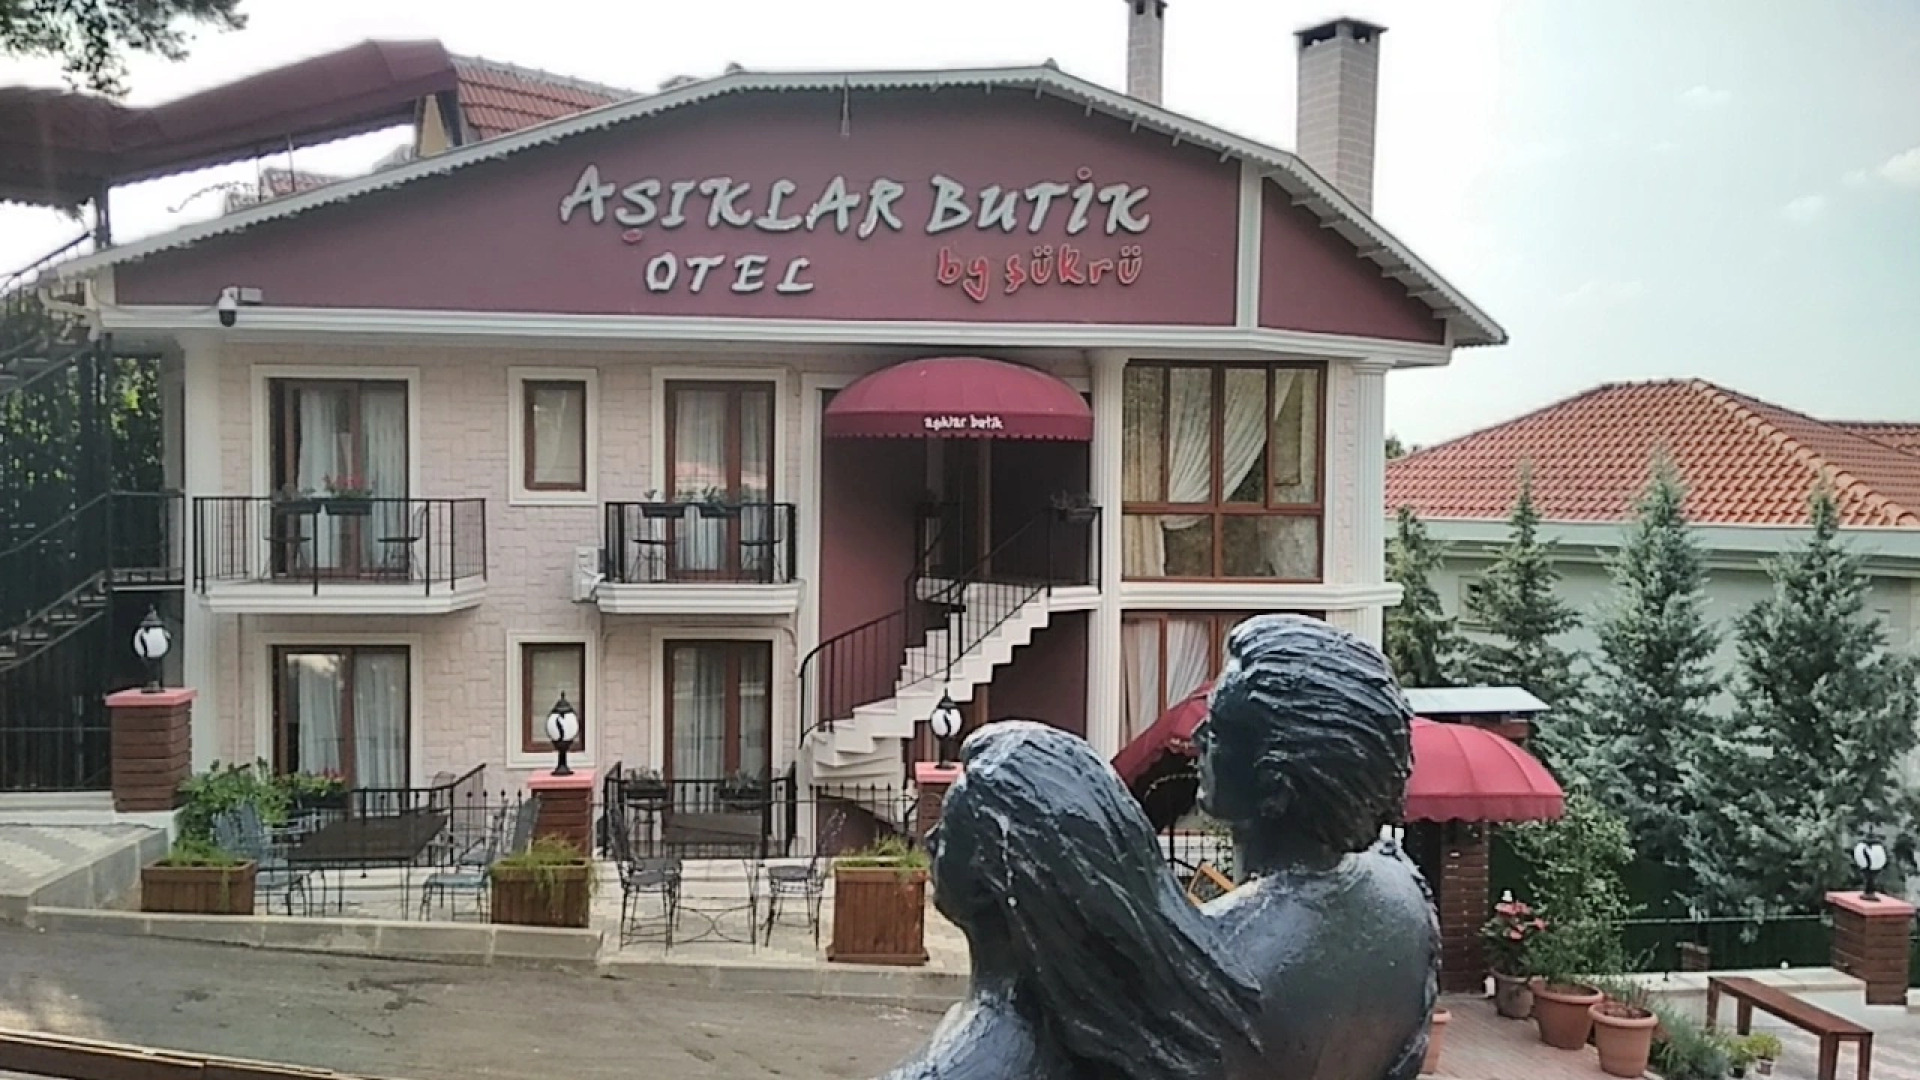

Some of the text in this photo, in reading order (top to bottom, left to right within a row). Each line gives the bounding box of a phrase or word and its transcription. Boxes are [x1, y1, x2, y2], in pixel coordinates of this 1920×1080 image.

[559, 164, 1151, 245] AŞIKLAR BUTİK
[646, 251, 815, 292] OTEL
[936, 244, 1143, 302] by şükrü
